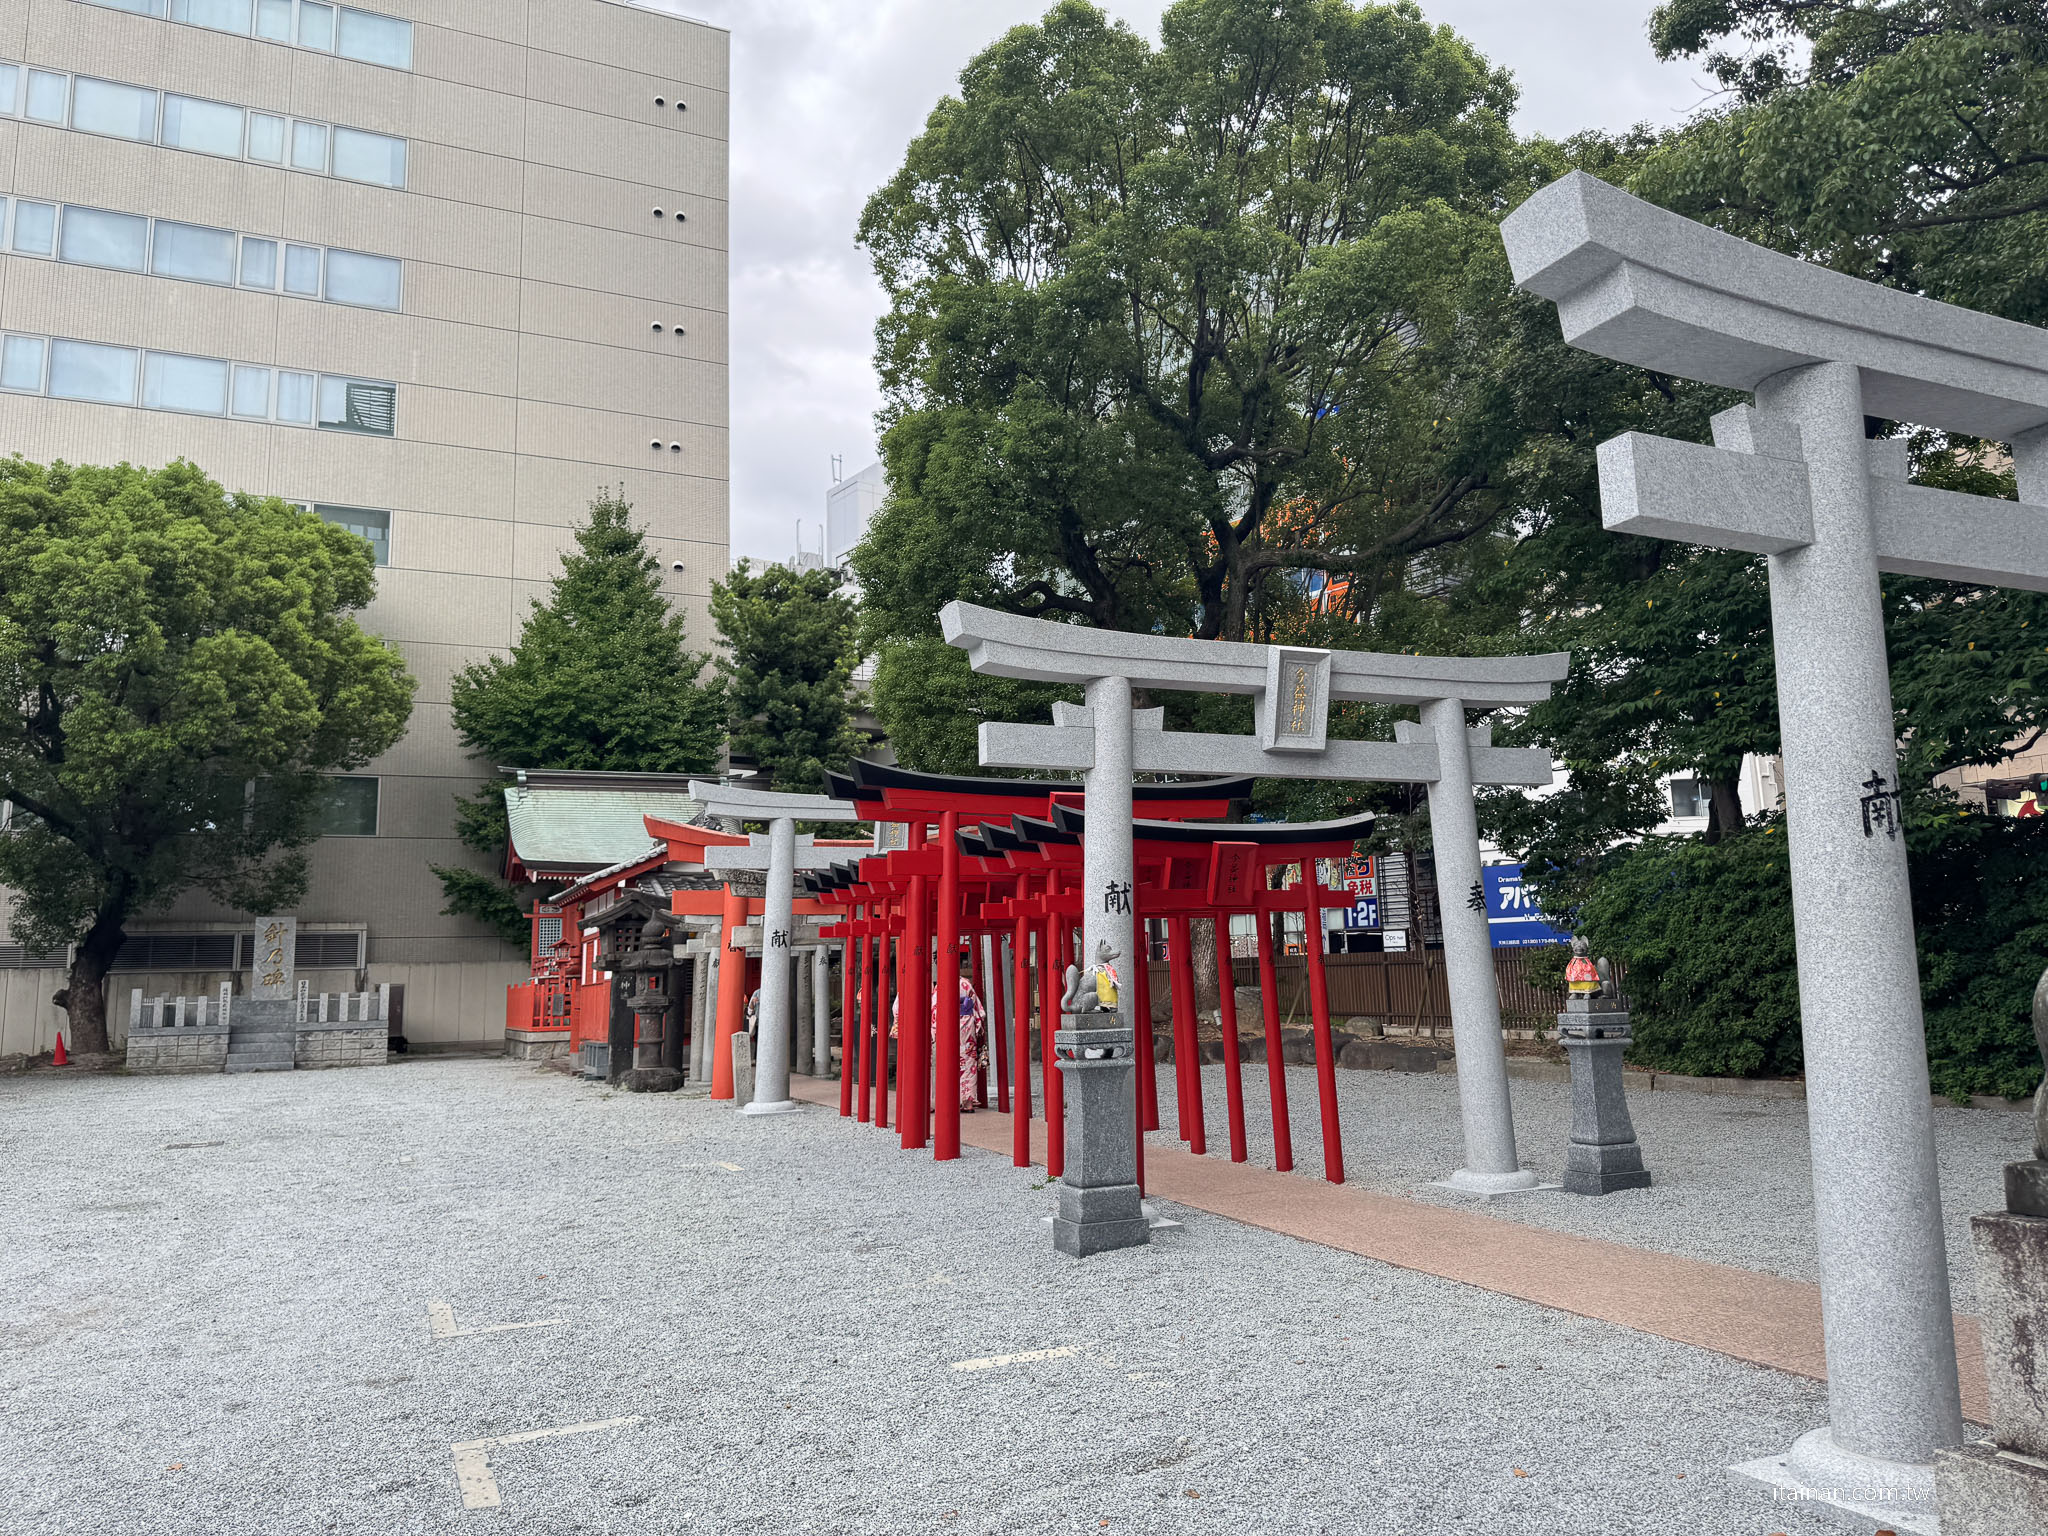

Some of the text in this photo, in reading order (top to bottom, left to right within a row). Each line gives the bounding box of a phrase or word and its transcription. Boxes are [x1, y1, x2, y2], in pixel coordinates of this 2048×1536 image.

[1104, 880, 1132, 915] 献
[1347, 879, 1373, 896] 免税
[1466, 880, 1487, 917] 奉
[771, 929, 789, 948] 献
